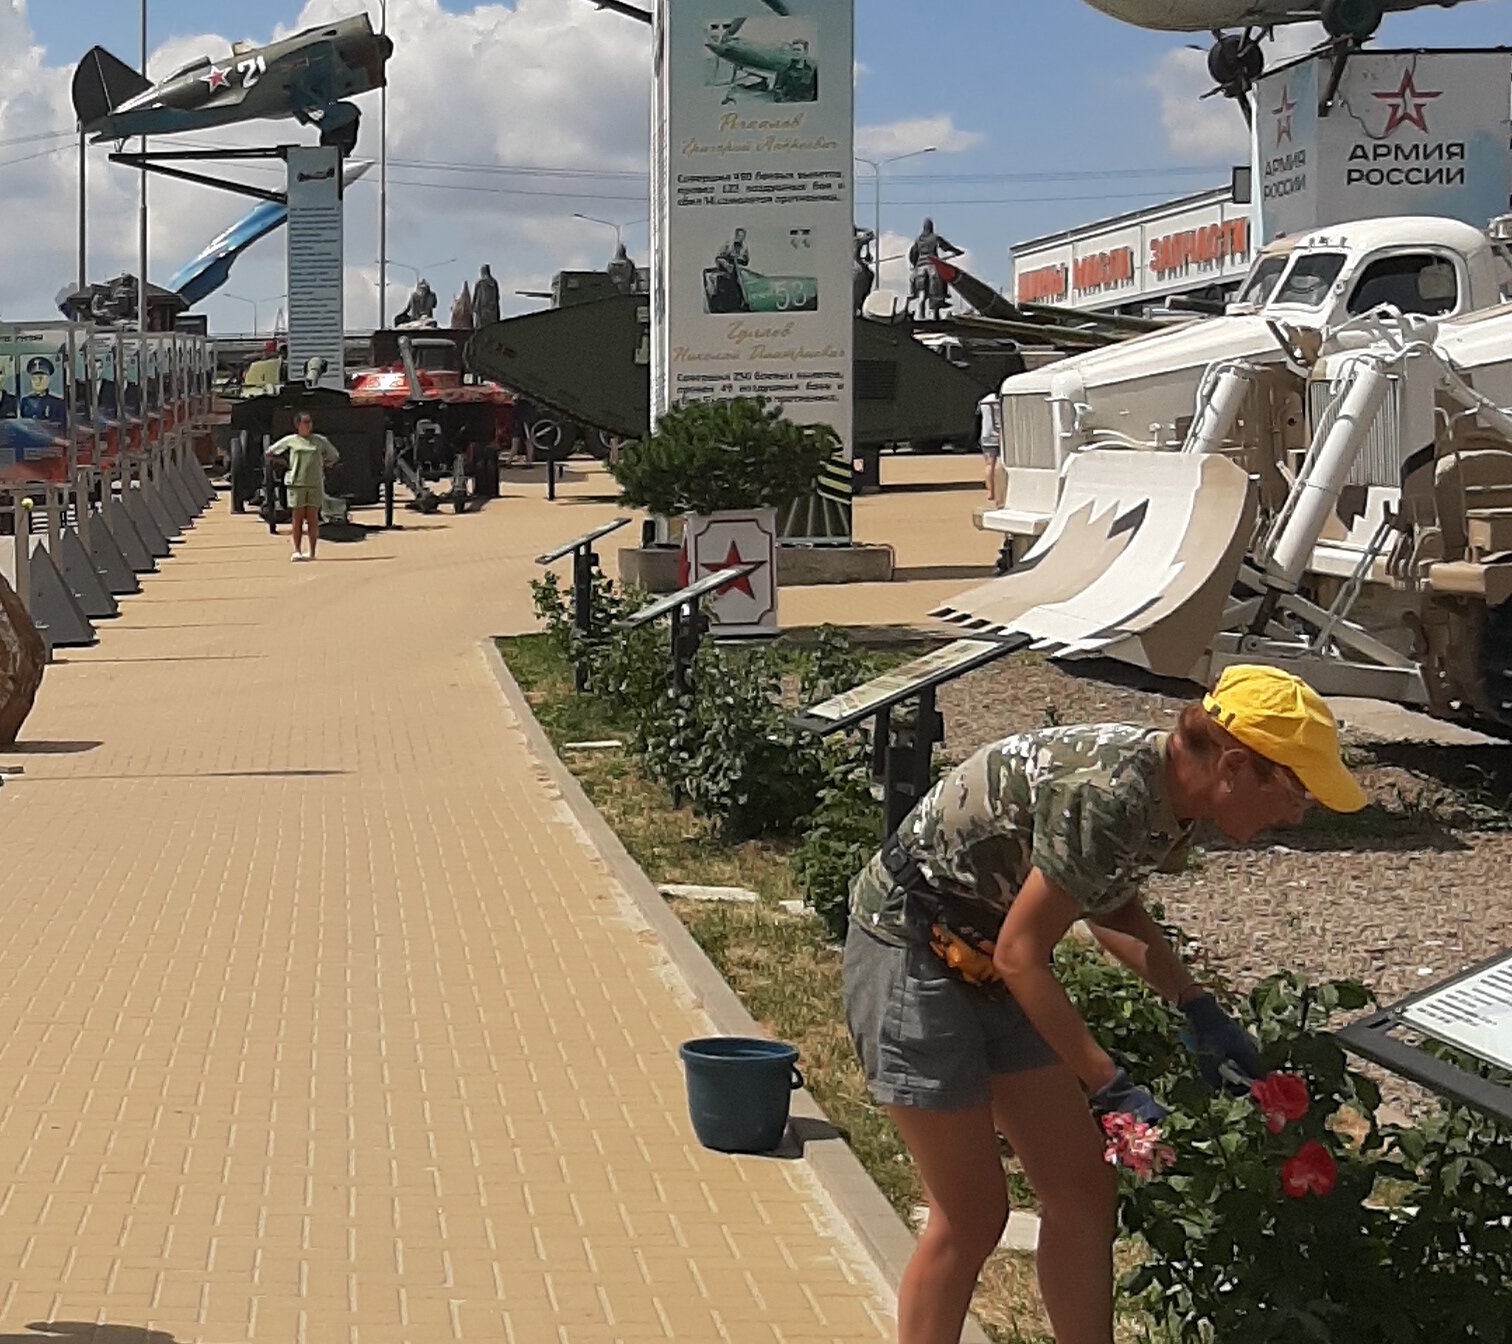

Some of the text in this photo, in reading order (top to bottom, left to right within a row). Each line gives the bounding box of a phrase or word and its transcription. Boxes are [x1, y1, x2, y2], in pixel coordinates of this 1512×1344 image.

[236, 55, 266, 88] 21
[1265, 149, 1306, 177] АРМИЯ
[1347, 143, 1466, 161] АРМИЯ
[1264, 174, 1307, 202] РОССИИ
[1346, 167, 1466, 186] РОССИИ
[1149, 216, 1249, 276] ЗАПЧАСТИ
